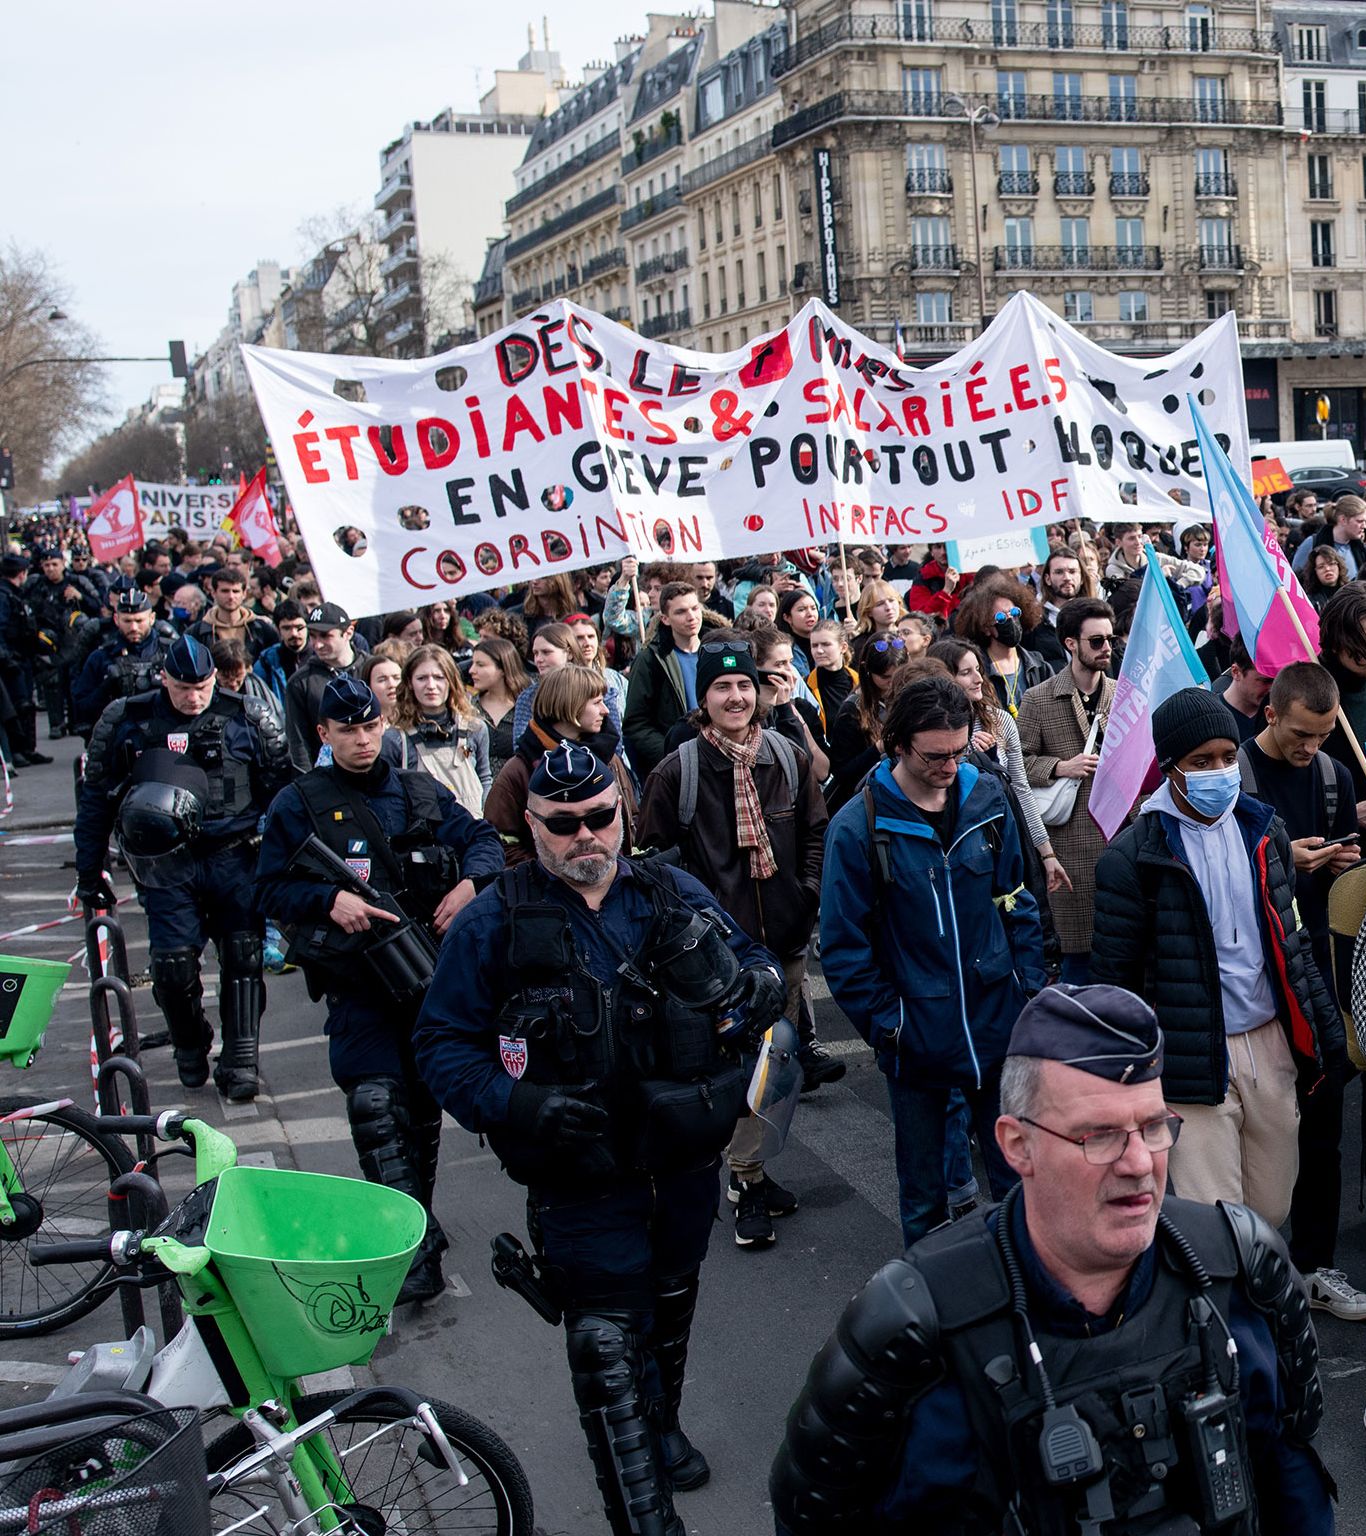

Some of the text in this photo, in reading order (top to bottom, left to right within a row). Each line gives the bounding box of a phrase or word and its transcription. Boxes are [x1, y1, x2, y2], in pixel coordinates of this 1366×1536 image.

[818, 151, 839, 305] HIPPOPOTAMUS
[496, 314, 606, 387] DÈS
[629, 348, 708, 397] LE
[708, 388, 754, 442] &
[445, 467, 530, 527] EN
[748, 432, 864, 490] POUR
[880, 427, 1013, 487] TOUT
[1001, 477, 1070, 522] IDF
[503, 1051, 525, 1063] CRS
